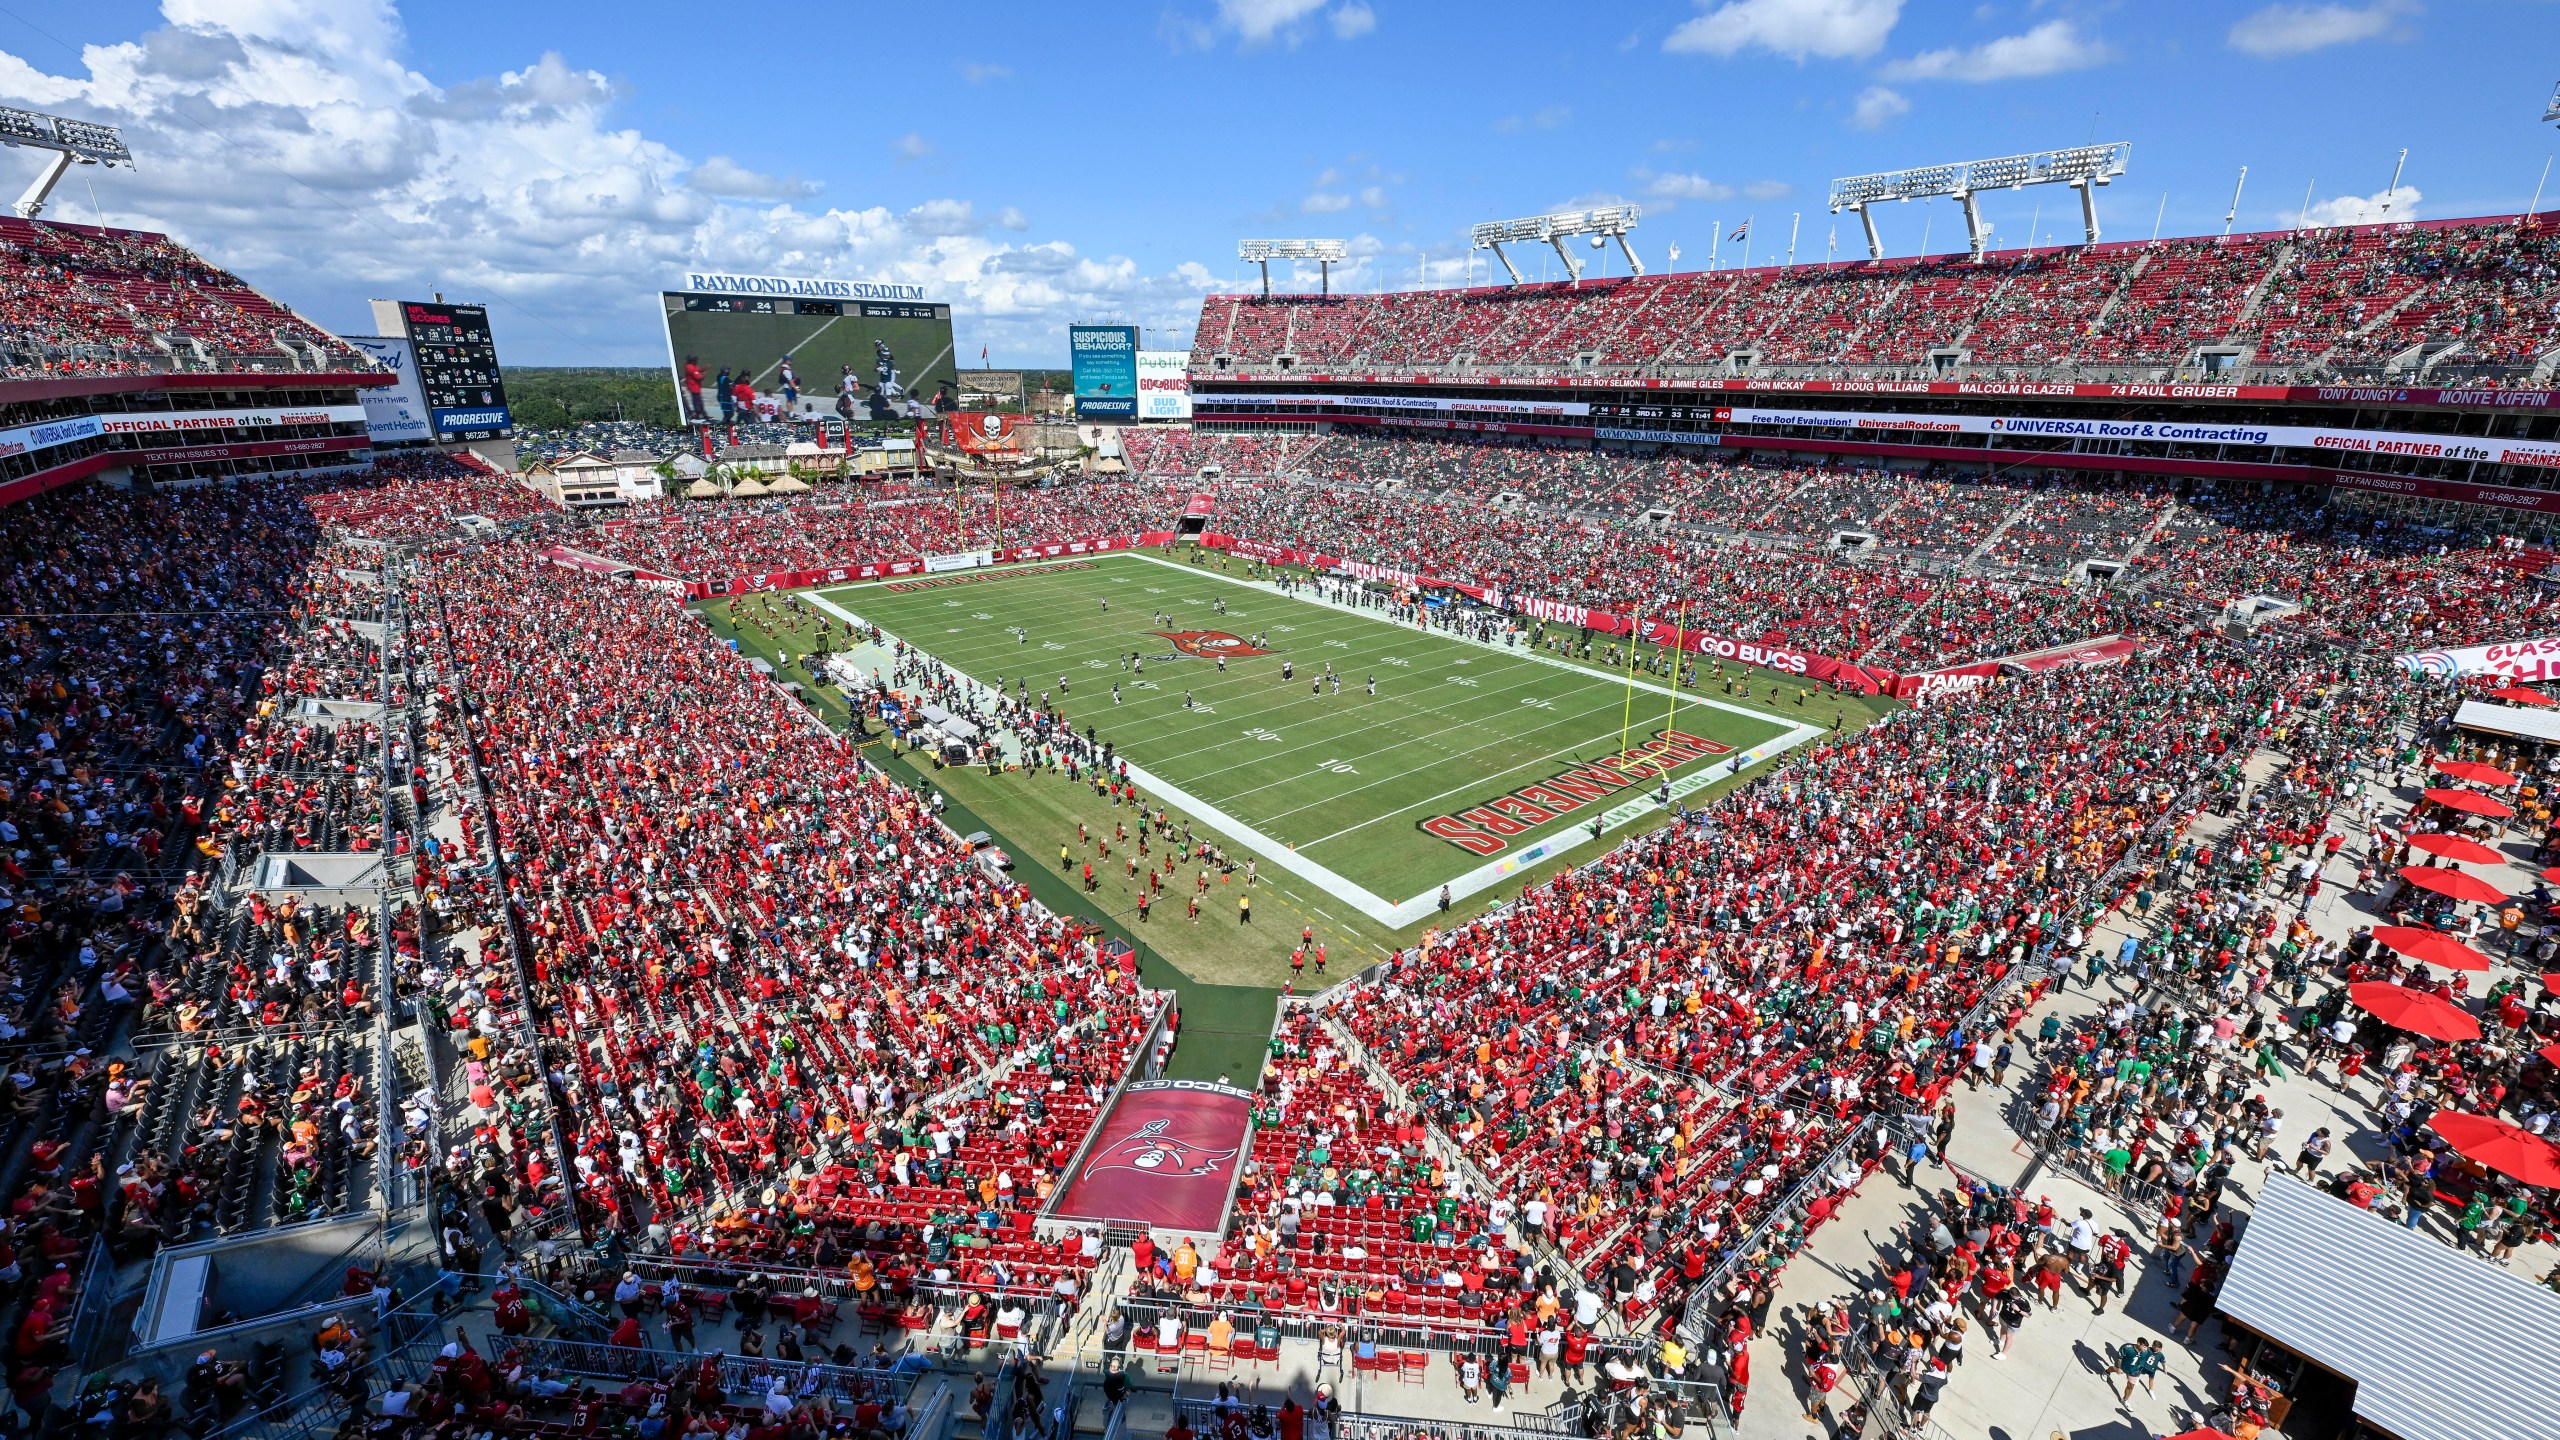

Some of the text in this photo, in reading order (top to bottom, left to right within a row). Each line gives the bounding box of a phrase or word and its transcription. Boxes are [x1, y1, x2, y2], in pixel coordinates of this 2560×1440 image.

[2395, 222, 2414, 231] 330
[690, 274, 924, 300] RAYMOND JAMES STADIUM
[407, 306, 427, 314] NFL
[410, 314, 450, 324] SCORES
[1073, 332, 1126, 342] SUSPICIOUS
[1075, 342, 1132, 350] BEHAVIOR?
[1140, 357, 1185, 368] Publix
[1140, 378, 1188, 390] GO BUCS
[1670, 380, 1697, 388] JIMMIE
[1772, 381, 1805, 390] MCKAY
[1831, 382, 1929, 392] 12 DOUG WILLIAMS
[1959, 384, 2075, 395] MALCOLM GLAZER
[2110, 386, 2238, 398] 74 PAUL GRUBER
[2318, 389, 2397, 401] TONY DUNGY
[1154, 398, 1176, 406] BUD
[1402, 399, 1438, 408] Contracting
[2438, 391, 2550, 406] MONTE KIFFIN
[1081, 402, 1131, 410] PROGRESSIVE
[1150, 407, 1181, 415] LIGHT
[1480, 404, 1509, 412] PARTNER
[103, 415, 272, 432] OFFICIAL PARTNER of the
[280, 414, 330, 424] BUCCANEERS
[443, 412, 503, 426] PROGRESSIVE
[1414, 420, 1448, 428] CHAMPIONS
[1752, 415, 1960, 431] Free Roof Evaluation! UniversalRoof.com
[366, 420, 426, 432] dventHealth
[2006, 420, 2268, 443] UNIVERSAL Roof & Contracting
[1596, 430, 1719, 445] RAYMOND JAMES STADIUM
[284, 442, 325, 451] 813-680-2827
[2314, 436, 2488, 459] OFFICIAL PARTNER of the
[145, 453, 168, 461] TEXT
[187, 450, 216, 459] ISSUES
[2336, 475, 2416, 491] TEXT FAN ISSUES TO
[2478, 490, 2541, 506] 813-680-2827
[1483, 590, 1587, 627] BUCANEERS
[1700, 636, 1807, 673] GO BUCS
[1243, 728, 1276, 742] 20
[1316, 758, 1351, 773] 10
[1418, 729, 1740, 856] BUCCANEERS
[1875, 1034, 1886, 1044] 12
[1173, 1080, 1254, 1099] GEICO
[297, 1133, 302, 1141] 6
[1180, 1254, 1188, 1264] 31
[509, 1300, 522, 1317] 78
[1262, 1338, 1272, 1348] 17
[574, 1413, 586, 1427] 13
[1232, 1425, 1242, 1436] 13
